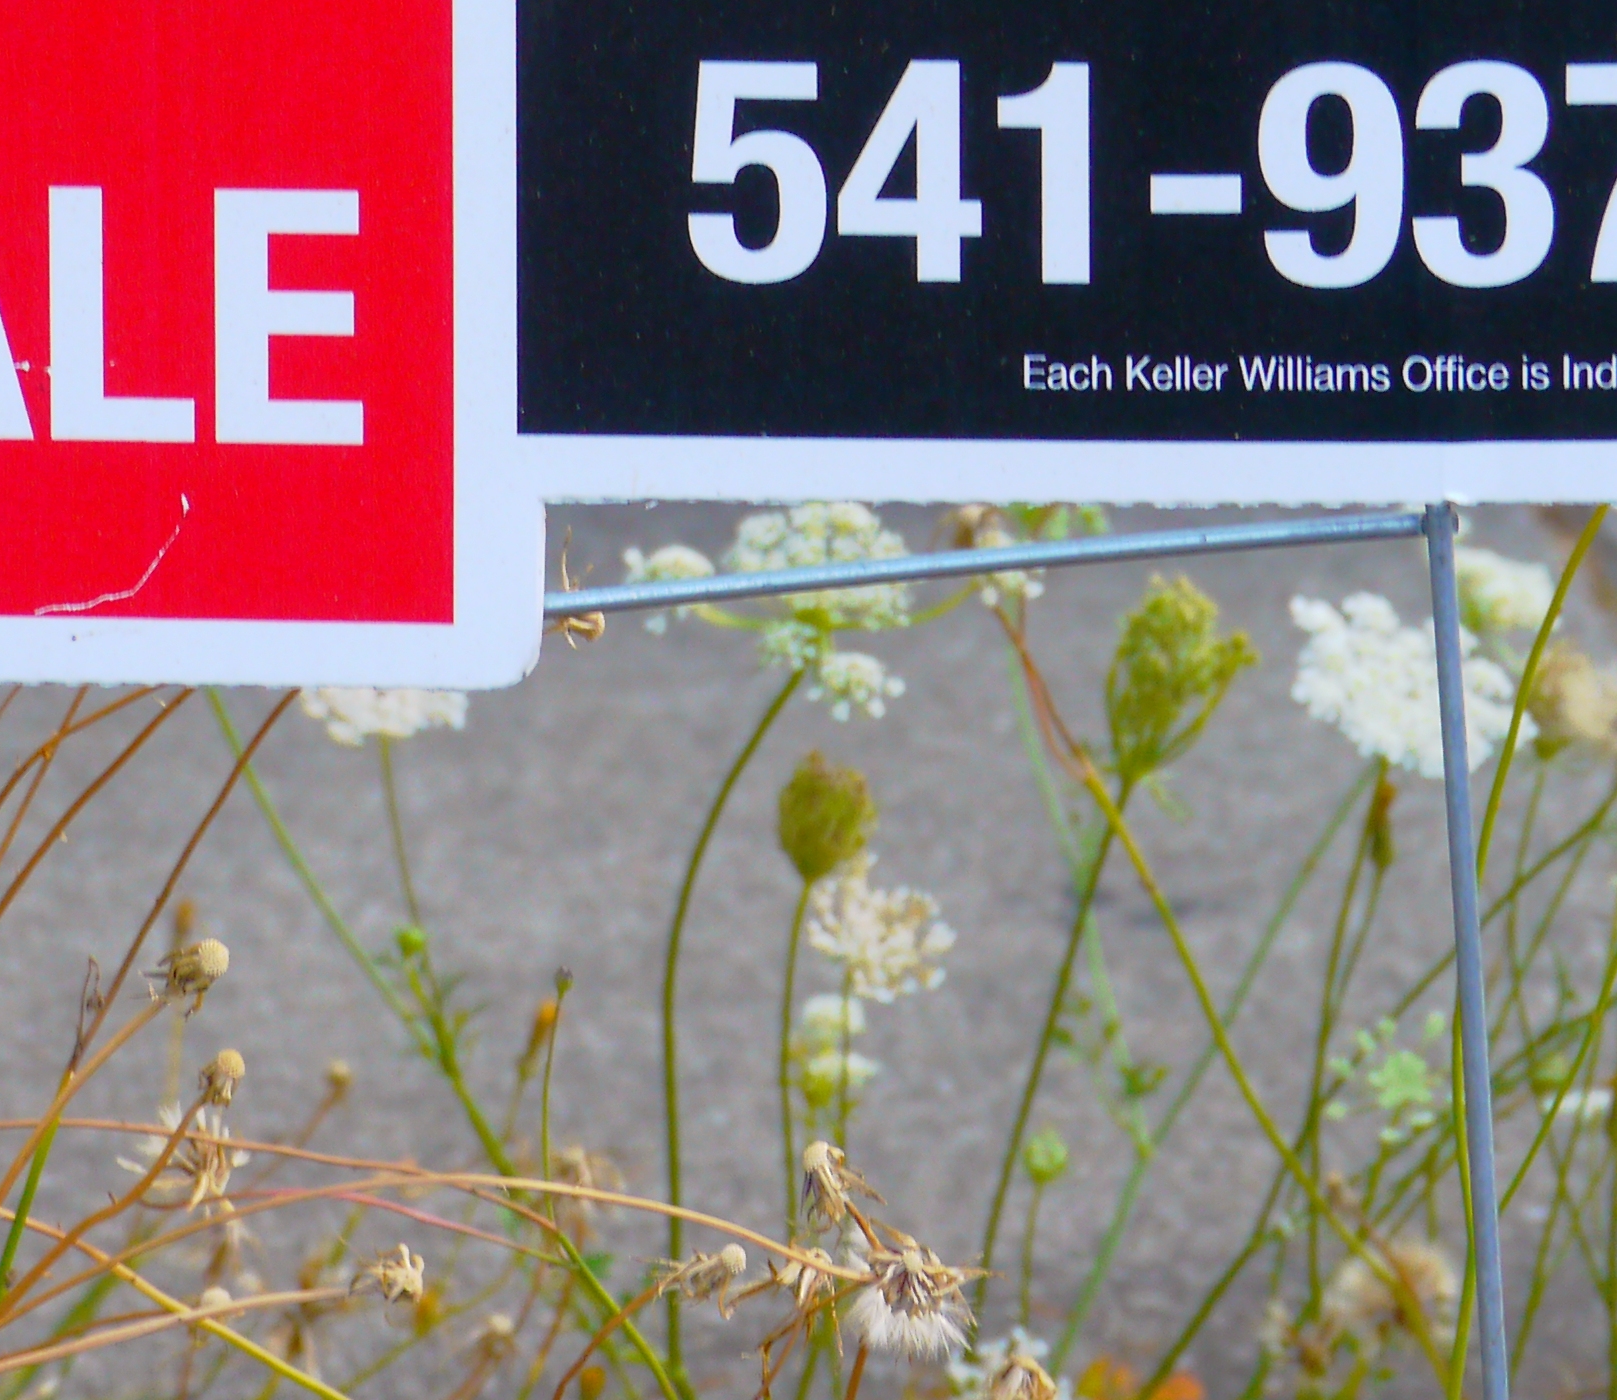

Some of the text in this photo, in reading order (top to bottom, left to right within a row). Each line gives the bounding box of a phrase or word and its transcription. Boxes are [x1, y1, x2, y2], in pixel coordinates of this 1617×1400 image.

[1023, 354, 1113, 391] Each
[1126, 355, 1229, 391] Keller
[1239, 355, 1391, 392] Williams
[1402, 355, 1509, 392] Office
[1521, 355, 1550, 390] is
